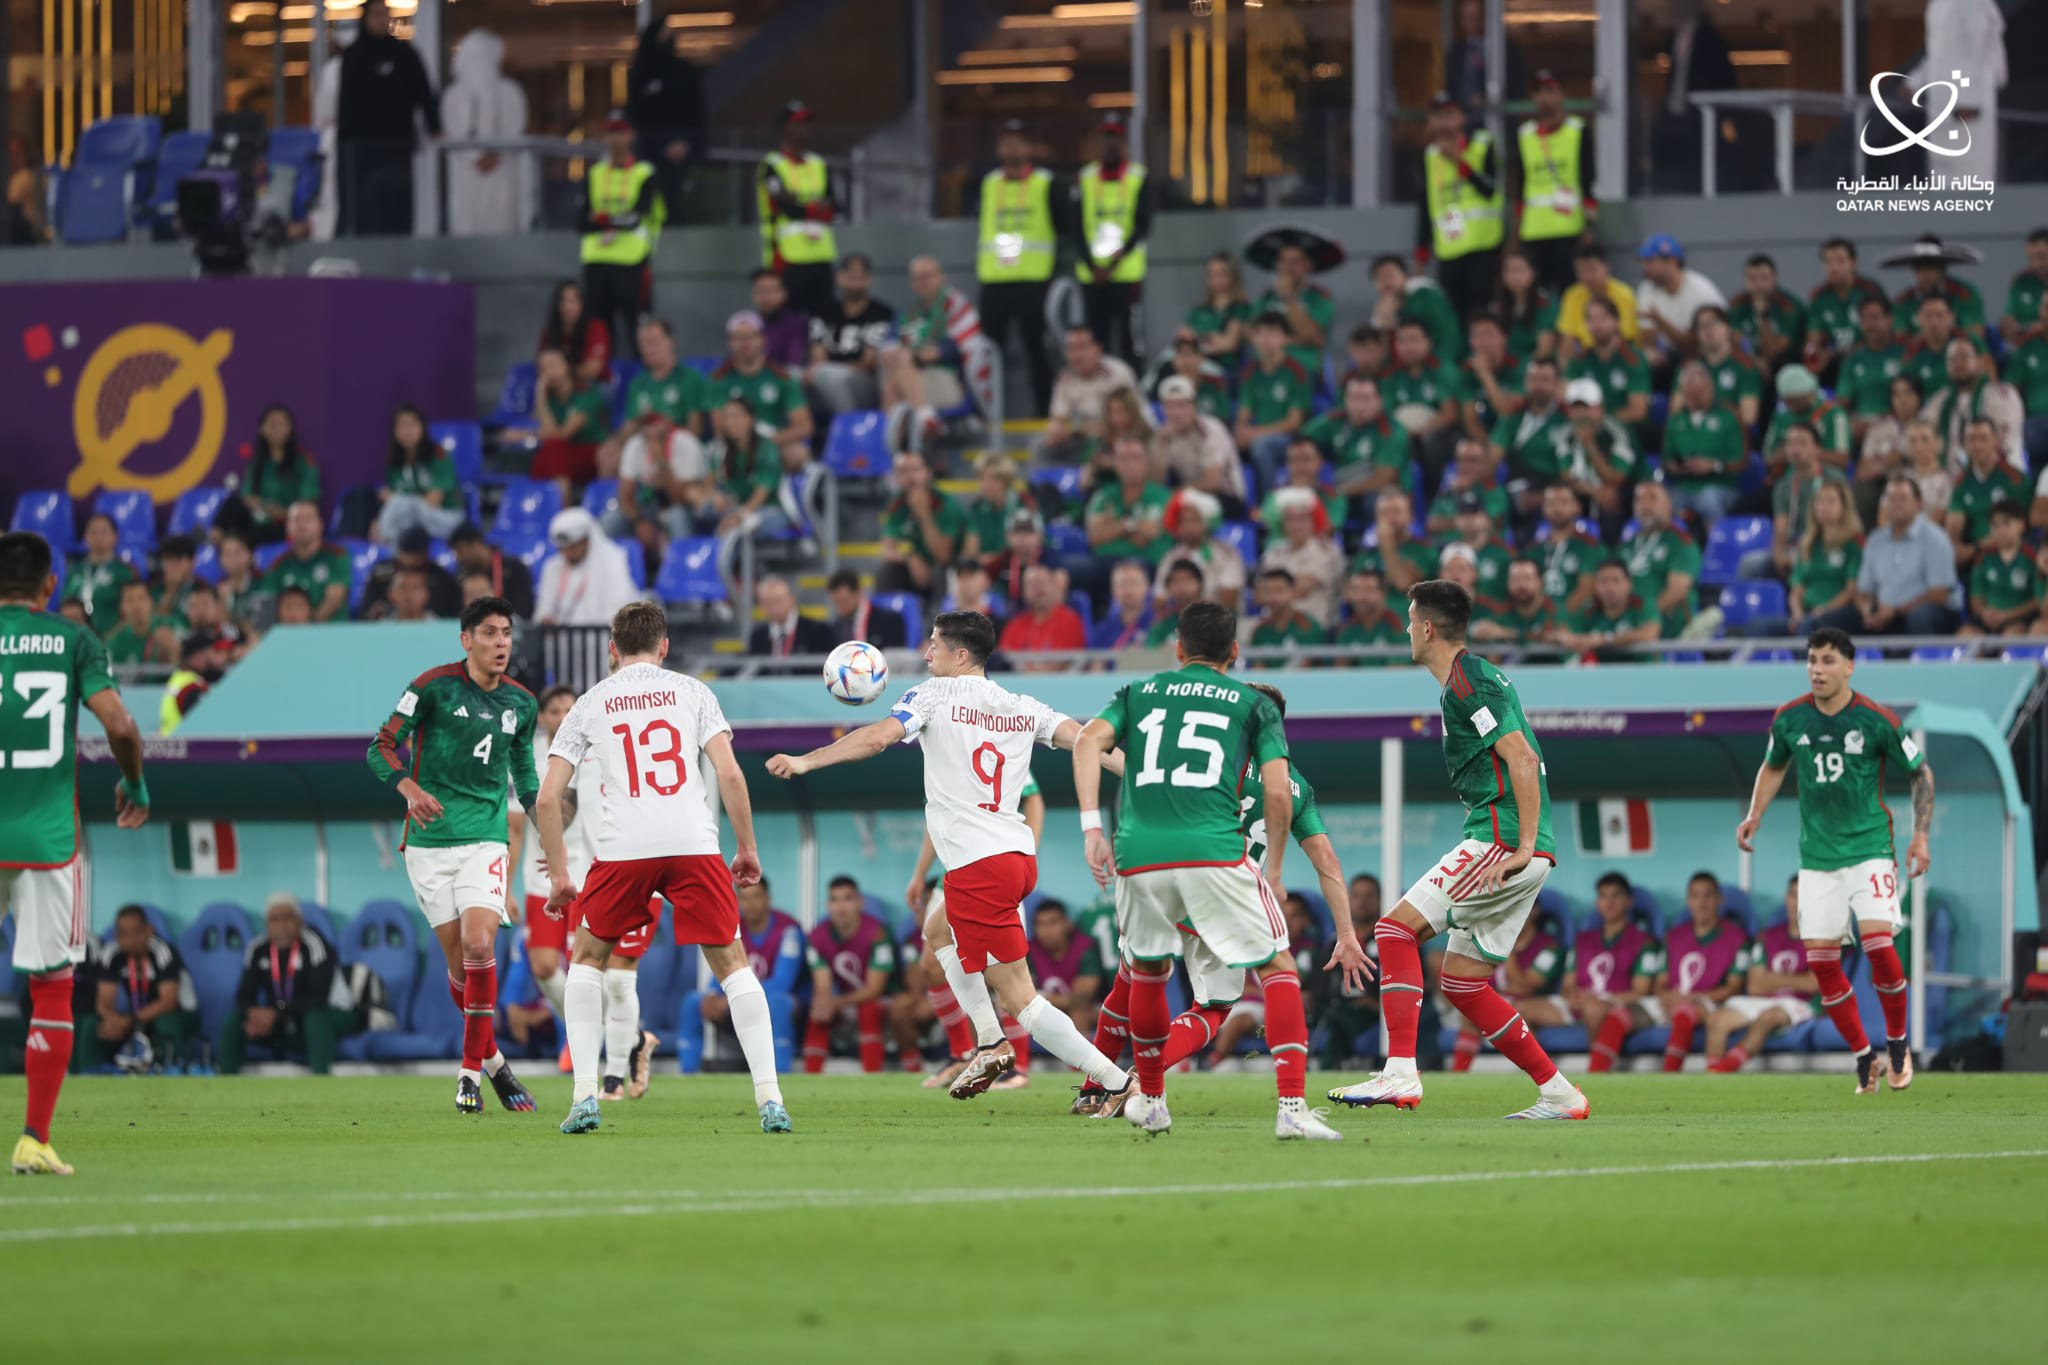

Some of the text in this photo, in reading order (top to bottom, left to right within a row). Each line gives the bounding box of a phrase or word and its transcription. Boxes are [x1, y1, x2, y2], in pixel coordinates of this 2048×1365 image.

[604, 690, 677, 715] KAMIŃSKI
[1142, 681, 1241, 704] H. MORENO
[0, 671, 68, 769] 3
[473, 732, 493, 765] 4
[612, 719, 687, 798] 13
[1135, 707, 1231, 789] 15
[972, 741, 1006, 813] 9
[1813, 751, 1845, 784] 19
[488, 858, 504, 883] 4
[1869, 873, 1896, 900] 19
